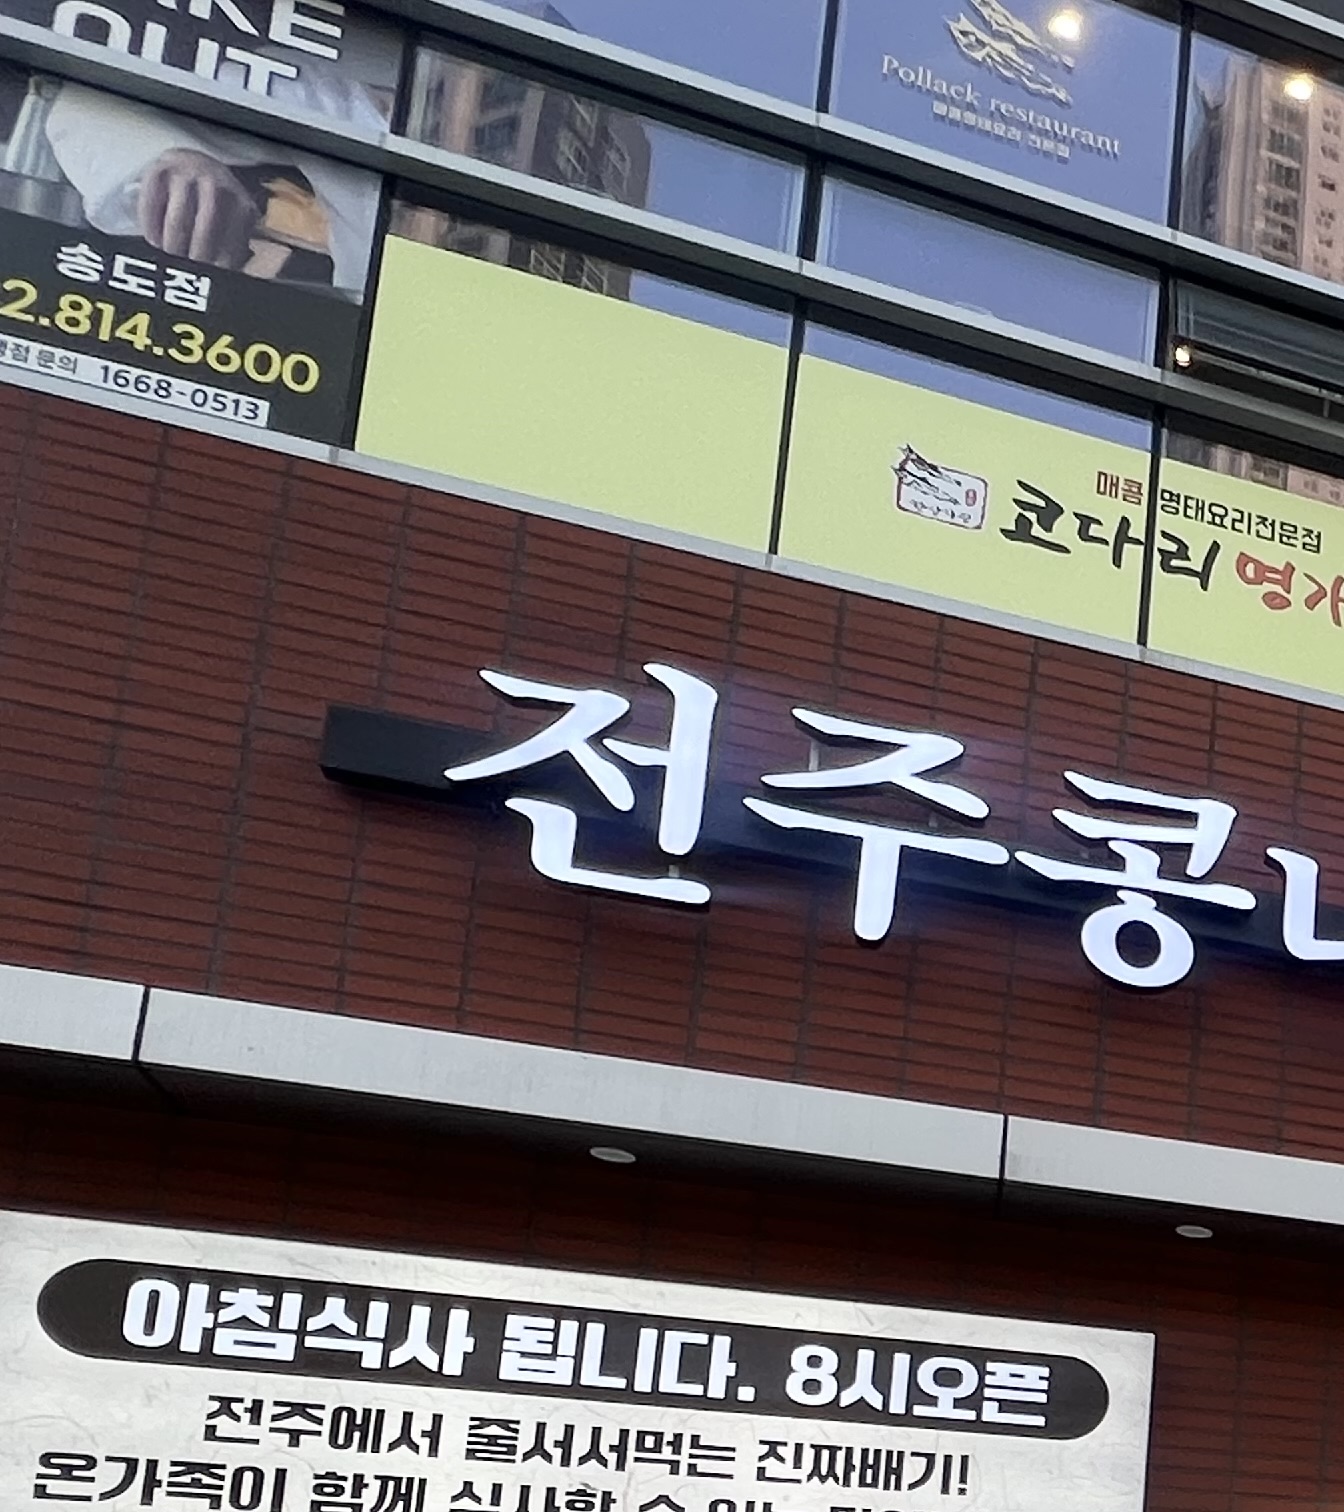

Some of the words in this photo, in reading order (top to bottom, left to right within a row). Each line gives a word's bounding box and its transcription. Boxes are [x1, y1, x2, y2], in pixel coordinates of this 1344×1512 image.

[882, 53, 981, 107] Pollack
[989, 97, 1121, 155] restaurant
[57, 242, 212, 312] 송도점
[35, 348, 78, 375] 문의
[100, 364, 260, 421] 1668-0513
[999, 479, 1221, 591] 코다리
[1096, 470, 1144, 506] 매콤
[1160, 487, 1323, 554] 명태요리전문점
[122, 1277, 476, 1377] 아침식사
[498, 1311, 755, 1402] 됩니다.
[785, 1345, 1050, 1428] 8시오픈
[203, 1395, 443, 1459] 전주에서
[466, 1416, 736, 1480] 줄서서먹는
[756, 1439, 969, 1497] 진짜배기!
